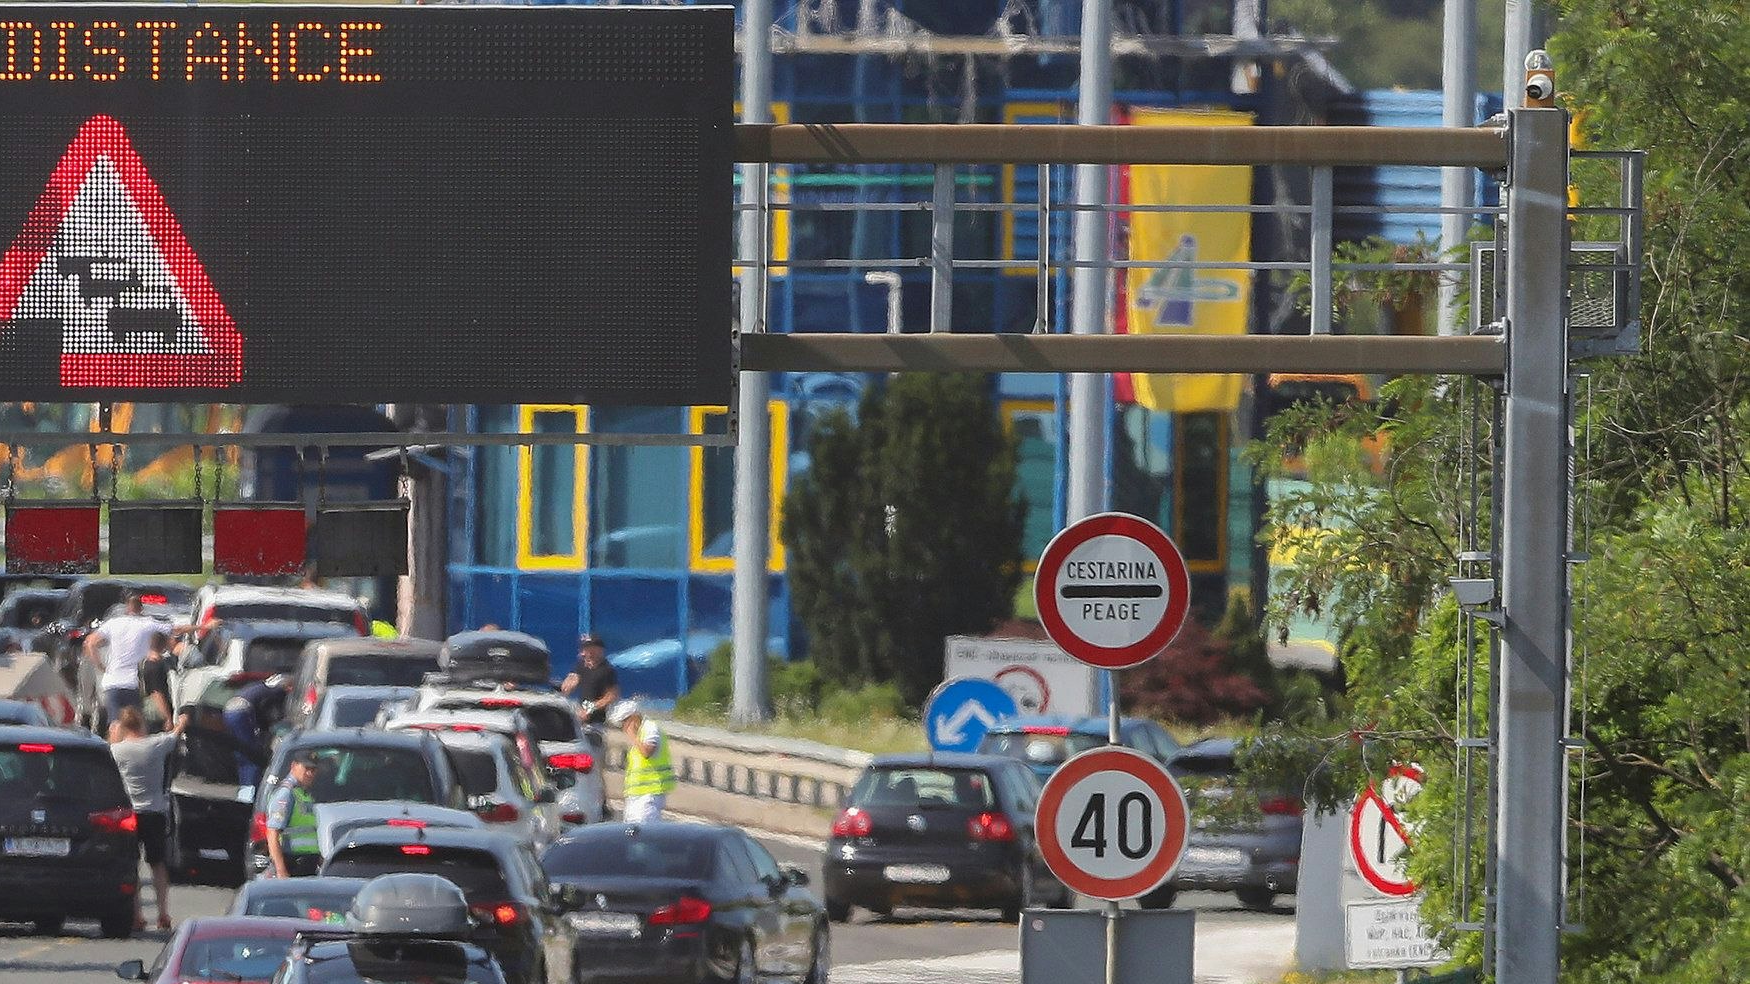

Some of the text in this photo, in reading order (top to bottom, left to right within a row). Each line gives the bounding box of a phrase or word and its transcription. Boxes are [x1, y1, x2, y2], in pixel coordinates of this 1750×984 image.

[1066, 560, 1158, 580] CESTARINA
[1082, 602, 1141, 621] PEAGE
[1070, 790, 1153, 860] 40
